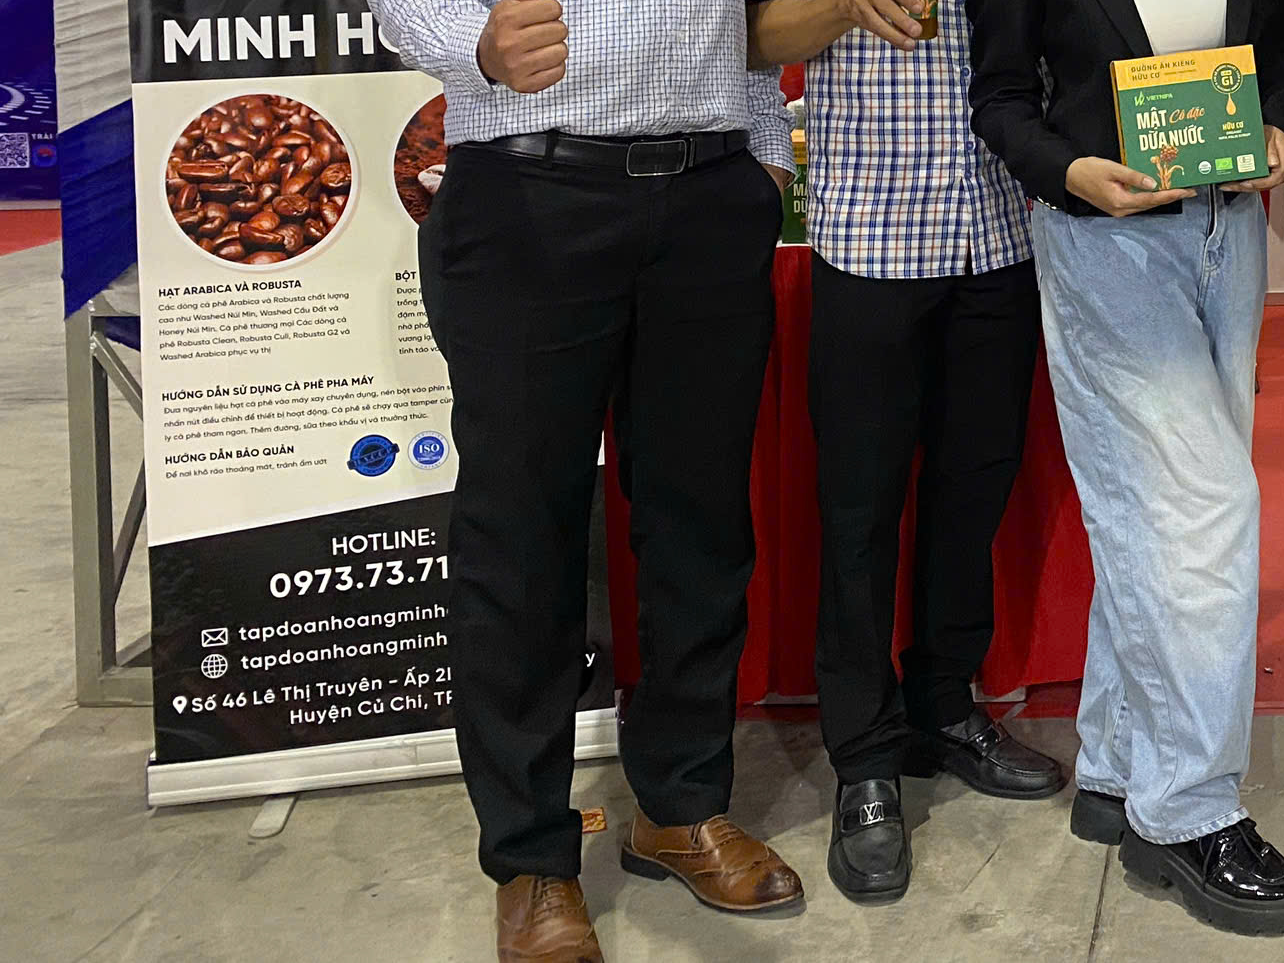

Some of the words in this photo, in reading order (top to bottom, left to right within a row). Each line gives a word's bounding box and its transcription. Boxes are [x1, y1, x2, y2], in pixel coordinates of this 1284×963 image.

[163, 13, 316, 64] MINH
[1136, 107, 1167, 131] MẬT
[1168, 124, 1206, 147] NƯỚC
[158, 287, 181, 299] HẠT
[183, 284, 232, 295] ARABICA
[235, 281, 249, 292] VÀ
[252, 279, 302, 291] ROBUSTA
[395, 270, 416, 282] BỘT
[162, 390, 204, 401] HƯỚNG
[206, 385, 230, 398] DẪN
[233, 384, 248, 396] SỬ
[249, 384, 282, 396] DỤNG
[284, 381, 301, 391] CÀ
[303, 378, 325, 390] PHÊ
[326, 378, 349, 388] PHA
[351, 375, 375, 386] MÁY
[165, 452, 207, 465] HƯỚNG
[209, 448, 233, 461] DẪN
[236, 447, 260, 459] BẢO
[262, 444, 295, 456] QUẢN
[419, 444, 440, 454] ISO
[331, 527, 437, 556] HOTLINE:
[269, 555, 449, 599] 0973.73.71
[238, 604, 449, 642] tapdoanhoangminh
[240, 632, 448, 672] tapdoanhoangminh
[191, 692, 217, 714] Số
[222, 691, 247, 711] 46
[253, 684, 276, 706] Lê
[281, 684, 311, 703] Thị
[316, 676, 383, 701] Truyên
[403, 667, 431, 690] Ấp
[290, 703, 353, 726] Huyện
[357, 698, 385, 717] Củ
[390, 694, 429, 713] Chi,
